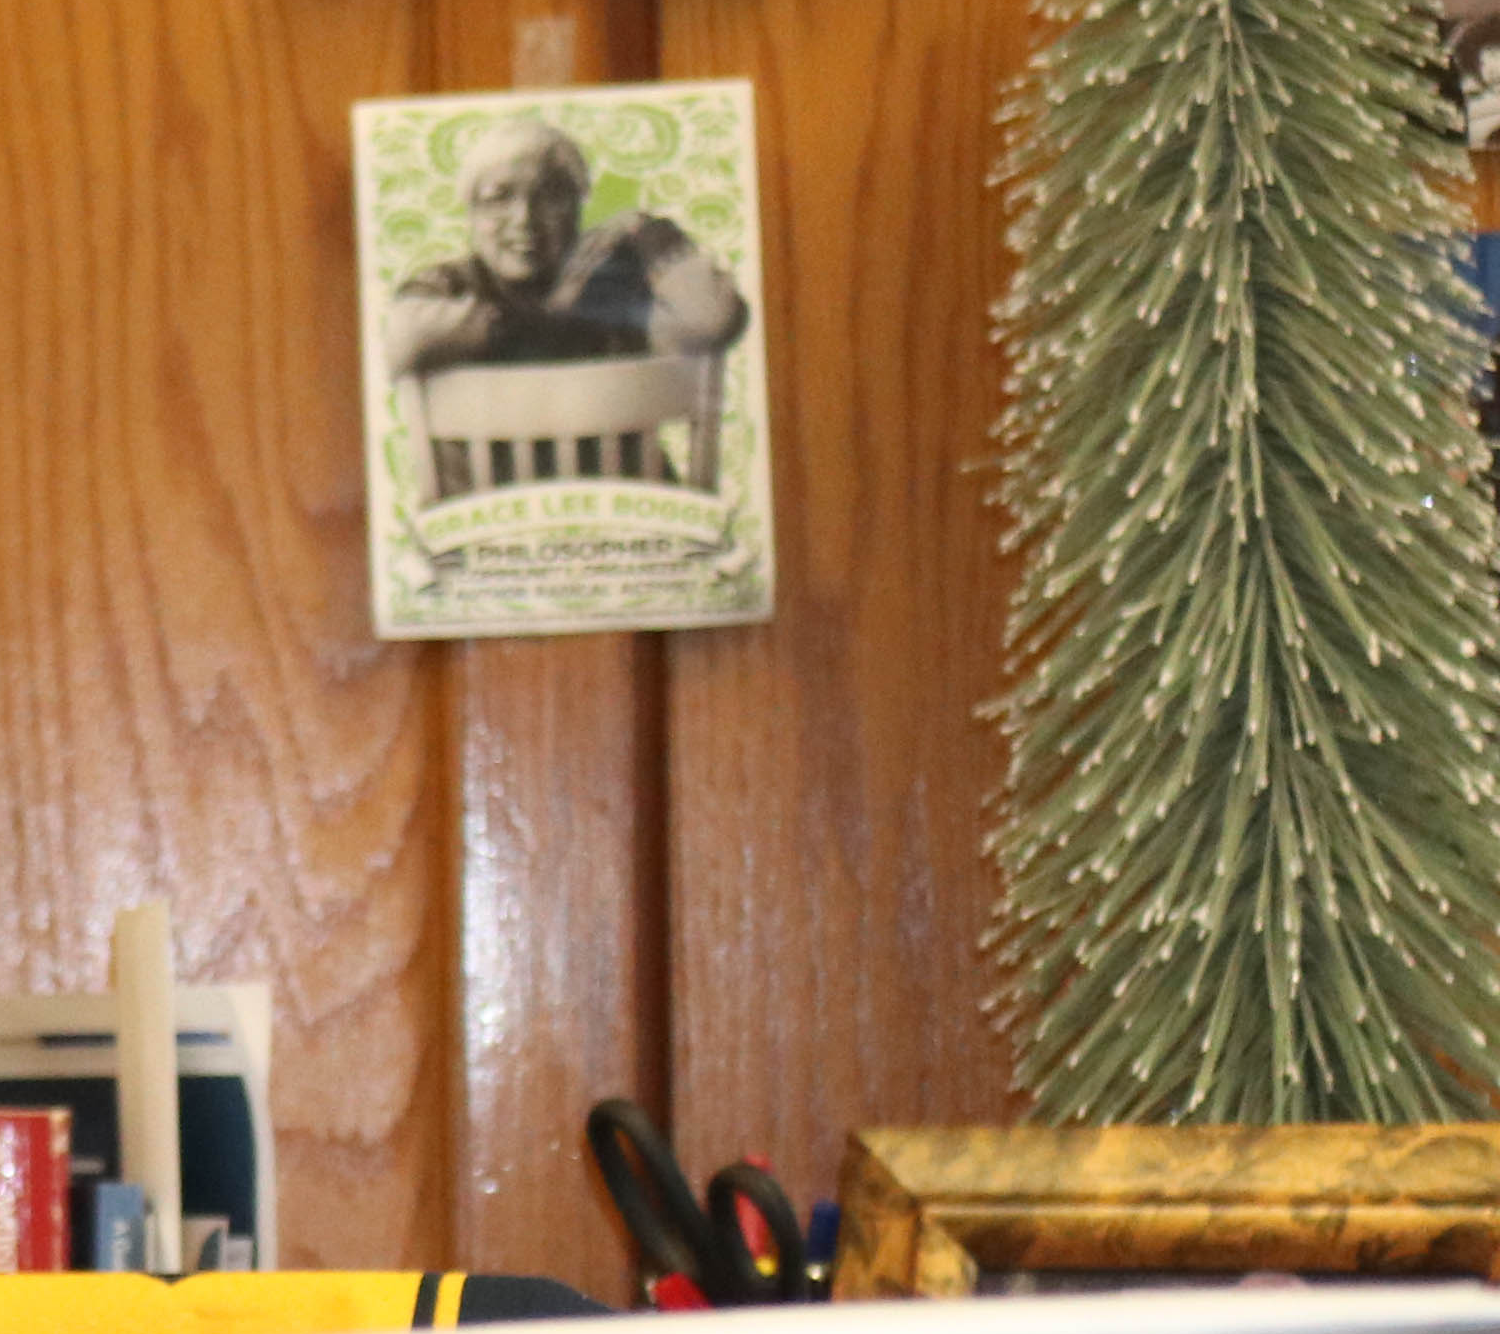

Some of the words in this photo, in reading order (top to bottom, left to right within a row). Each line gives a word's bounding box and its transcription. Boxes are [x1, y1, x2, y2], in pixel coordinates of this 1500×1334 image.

[424, 498, 528, 540] GRACE
[542, 492, 600, 517] LEE
[612, 492, 724, 533] BOGGS
[476, 538, 674, 562] PHILOSOPHER
